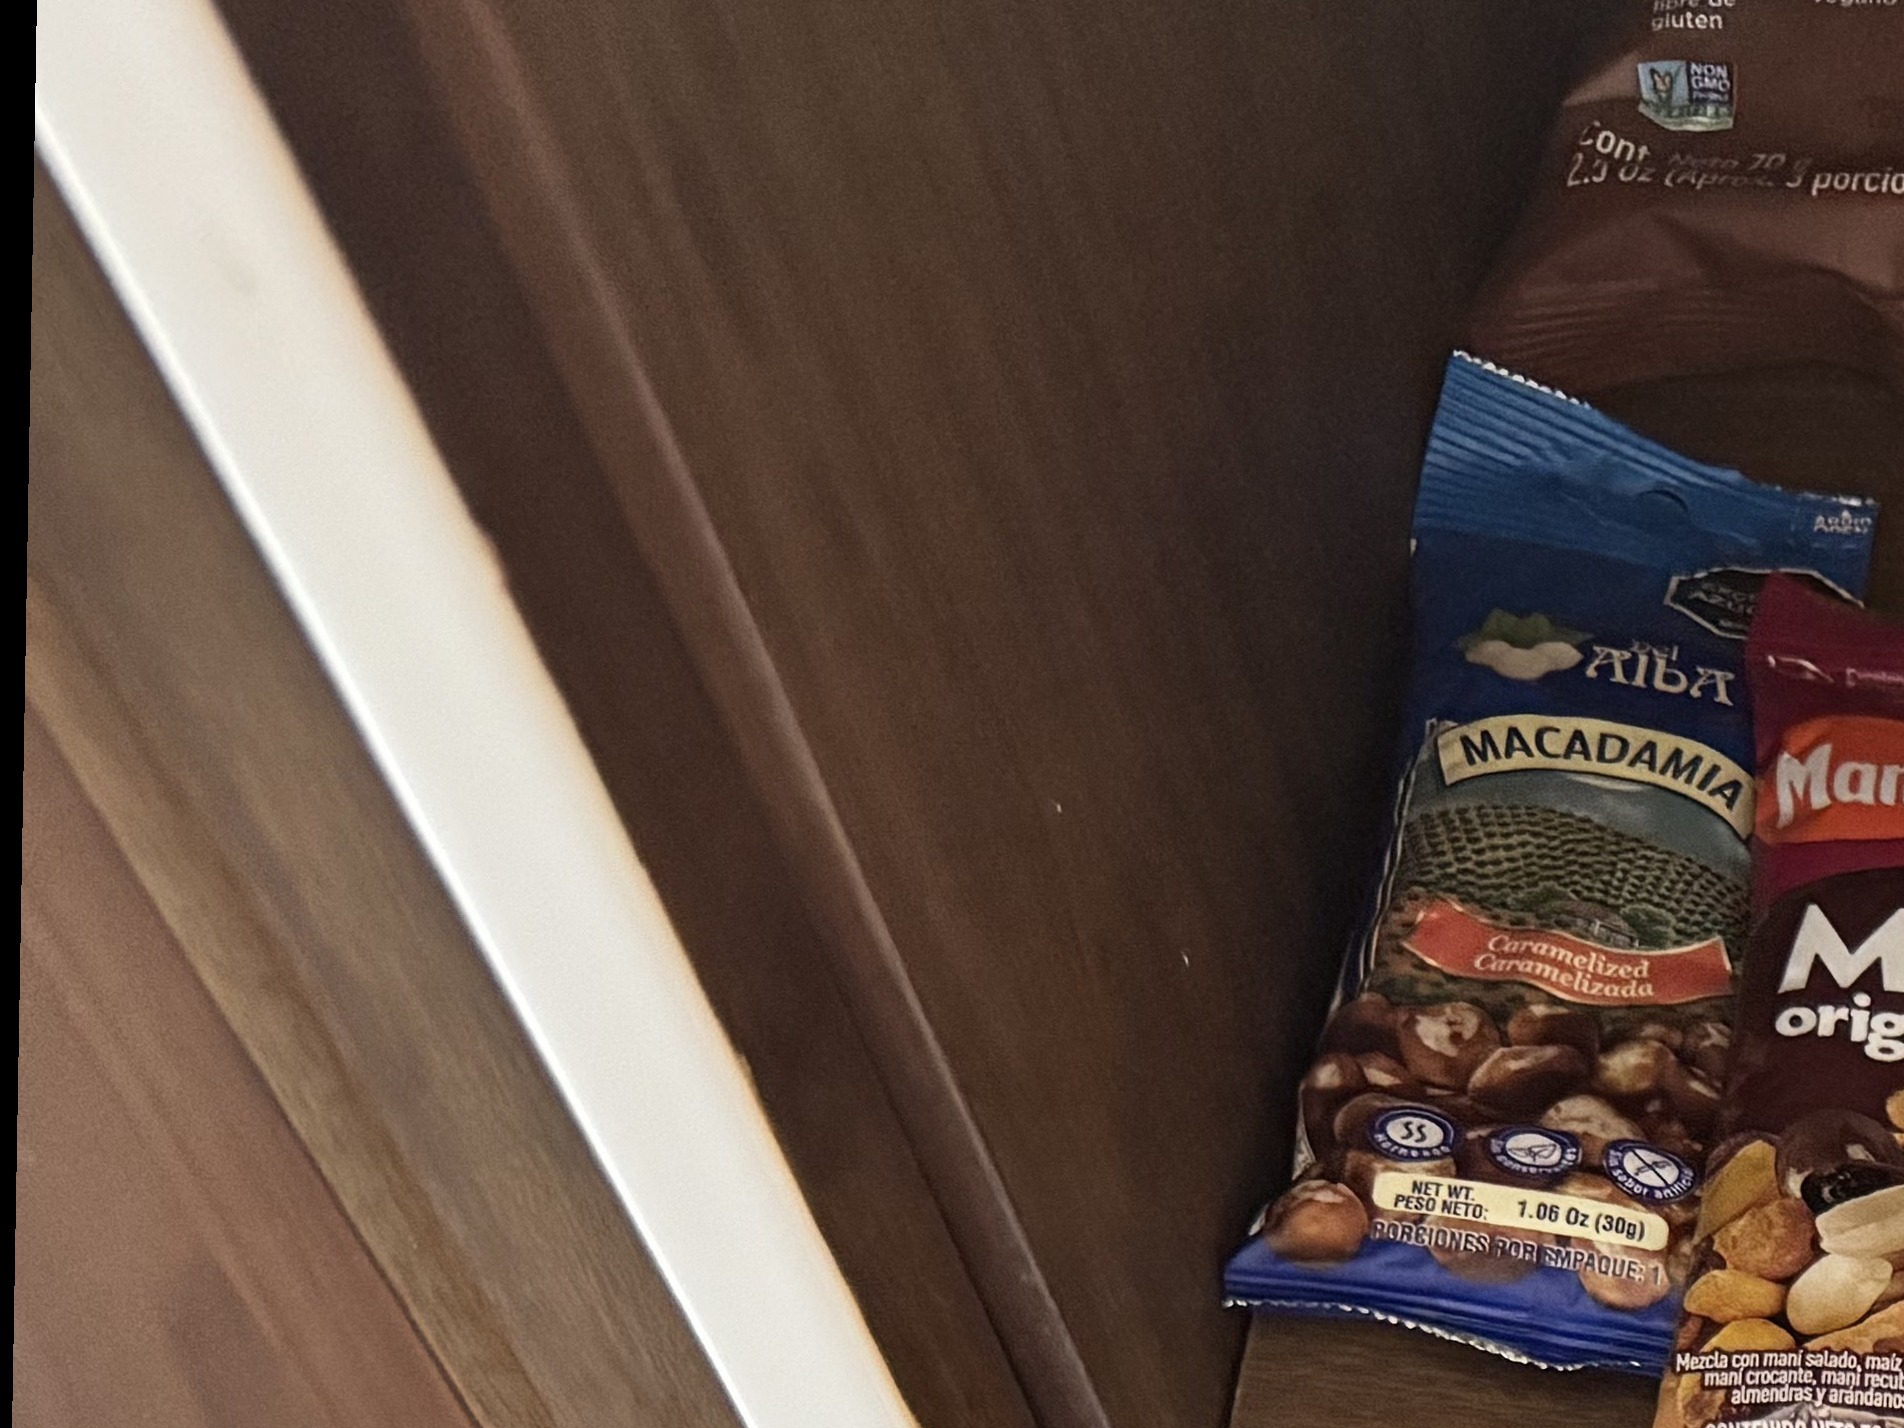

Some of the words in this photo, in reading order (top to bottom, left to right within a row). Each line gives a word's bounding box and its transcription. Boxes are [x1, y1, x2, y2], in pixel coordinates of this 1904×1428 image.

[1651, 12, 1723, 31] gluten
[1690, 63, 1728, 78] NON
[1459, 726, 1743, 810] MACADAMIA
[1487, 934, 1650, 981] Caramelized
[1475, 951, 1655, 1000] Caramelizada
[1412, 1180, 1444, 1197] NET
[1447, 1184, 1476, 1201] WT.
[1394, 1194, 1438, 1213] PESO
[1441, 1200, 1488, 1220] NETO:
[1518, 1200, 1560, 1222] 1.06
[1565, 1206, 1589, 1228] Oz
[1595, 1212, 1646, 1242] (30g)
[1371, 1219, 1489, 1253] PORCIONES
[1495, 1238, 1538, 1263] POR
[1544, 1246, 1646, 1282] EMPAQUE:
[1653, 1265, 1664, 1286] 1
[1675, 1352, 1729, 1372] Mezcla
[1732, 1356, 1760, 1370] con
[1763, 1352, 1802, 1371] maní
[1805, 1351, 1860, 1372] salado,
[1865, 1355, 1901, 1374] maíz
[1704, 1366, 1743, 1387] maní
[1746, 1369, 1816, 1387] crocante,
[1820, 1370, 1860, 1388] maní
[1731, 1385, 1813, 1404] almendras
[1816, 1390, 1826, 1406] y
